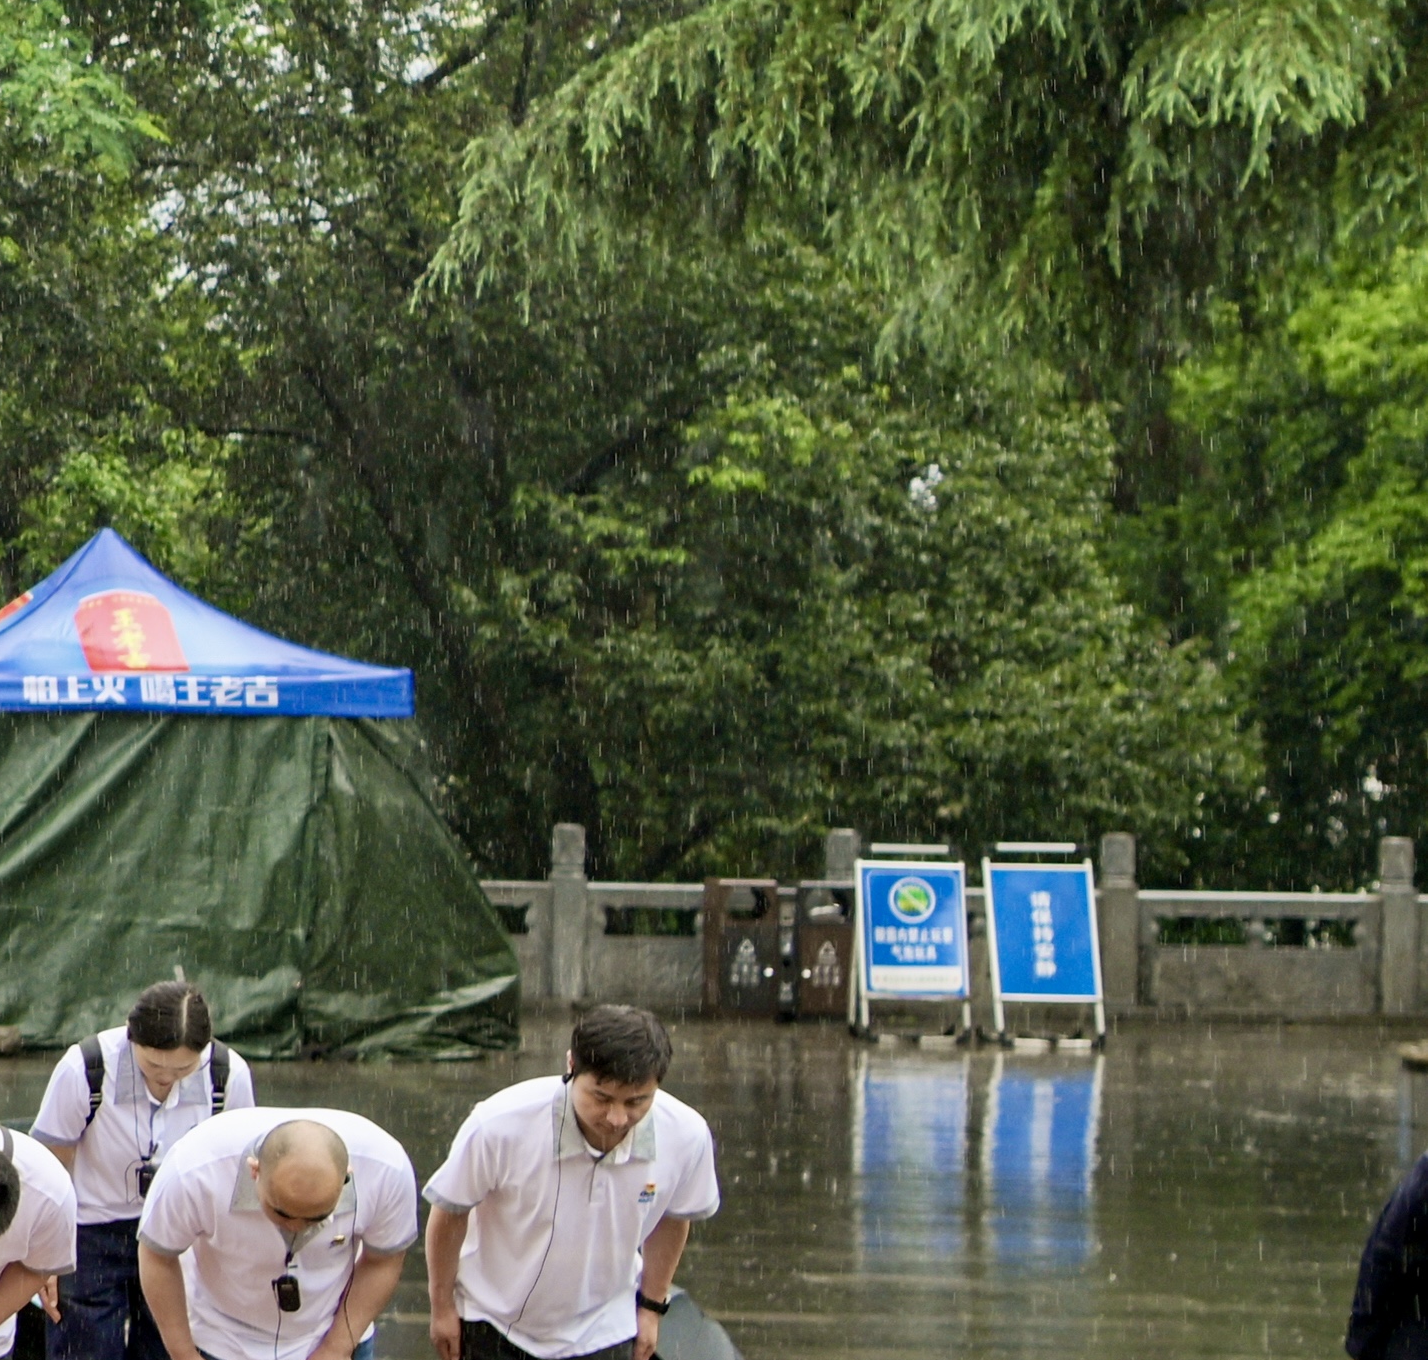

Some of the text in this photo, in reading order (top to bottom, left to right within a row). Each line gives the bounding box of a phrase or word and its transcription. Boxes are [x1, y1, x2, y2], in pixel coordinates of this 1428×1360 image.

[22, 674, 279, 707] 怕上火 喝王老吉
